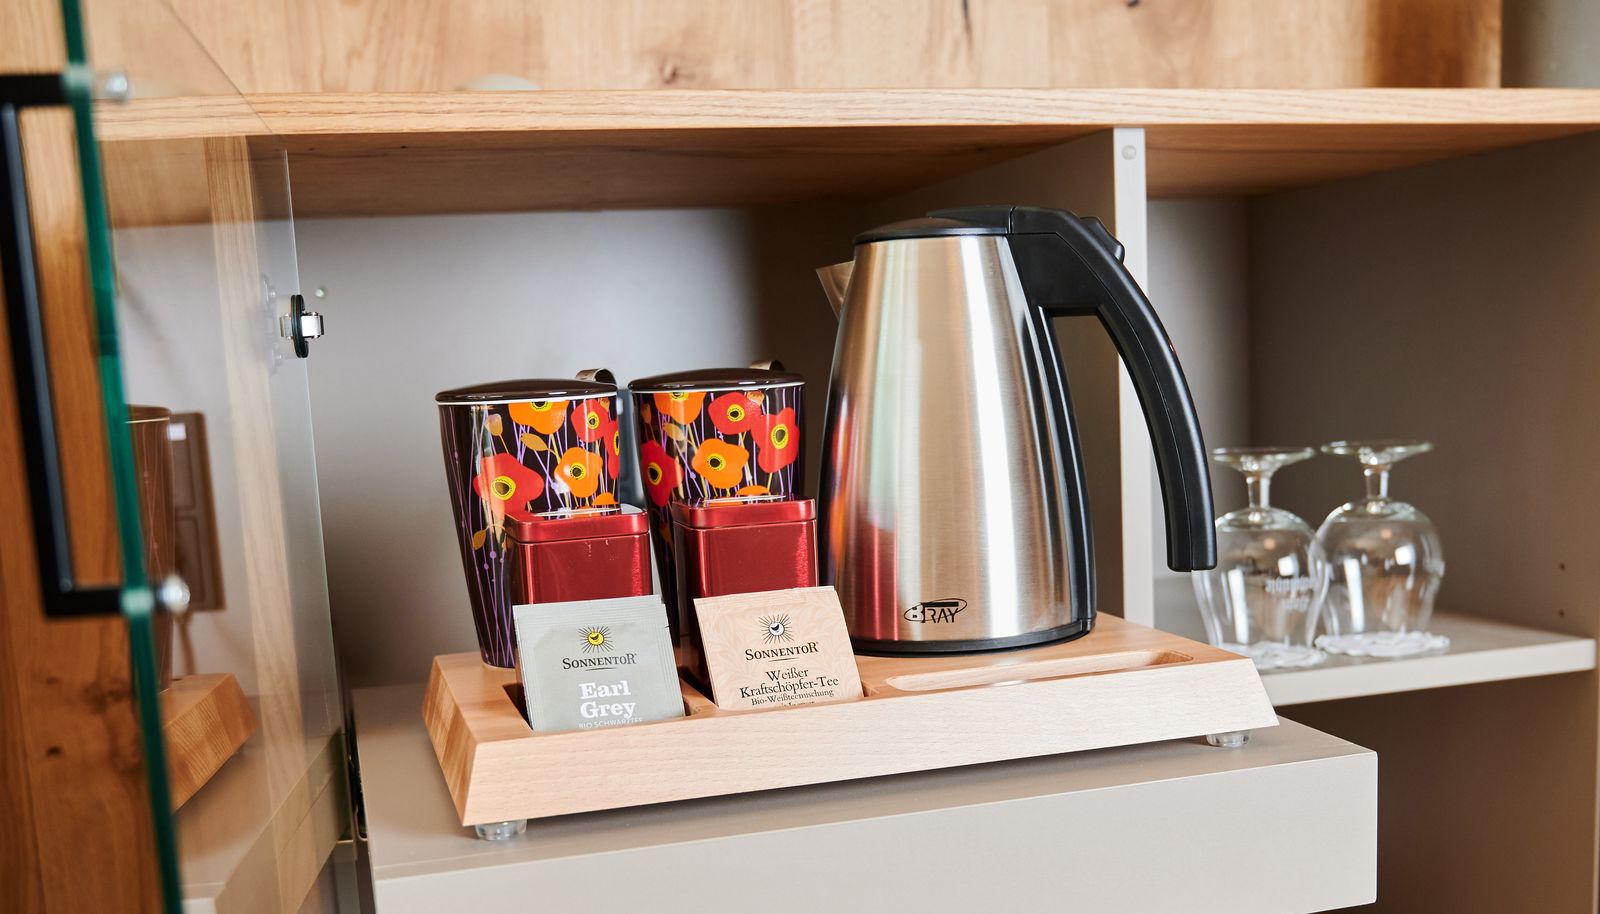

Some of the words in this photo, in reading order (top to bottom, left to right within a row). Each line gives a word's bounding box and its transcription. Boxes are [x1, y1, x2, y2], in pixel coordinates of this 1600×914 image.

[765, 667, 809, 681] Weißer
[578, 680, 631, 699] Earl
[739, 676, 839, 698] Kraftschöpfer-Tee
[580, 701, 636, 719] Grey
